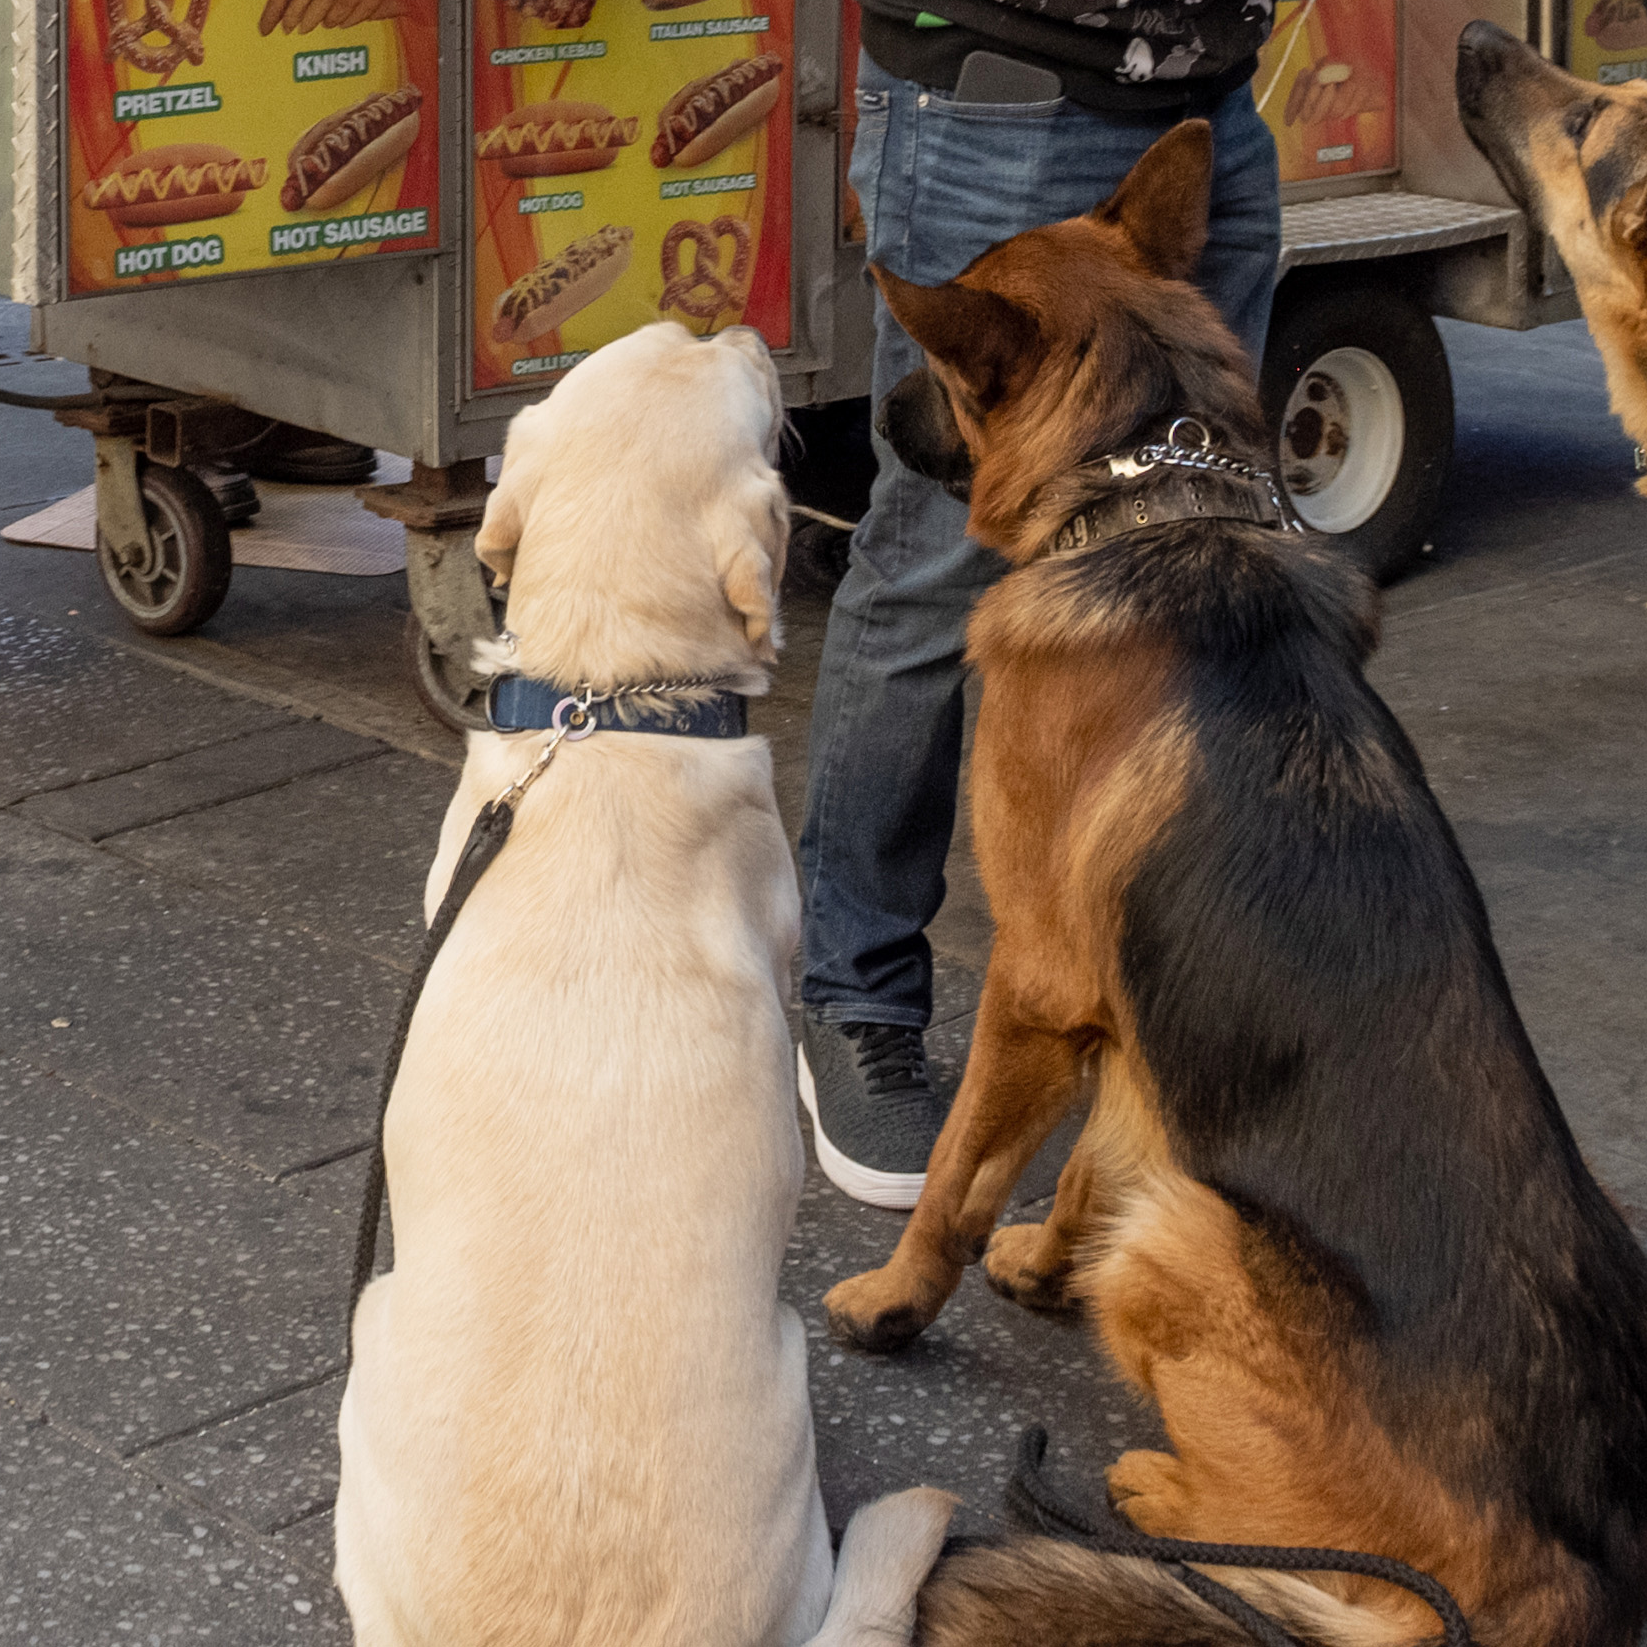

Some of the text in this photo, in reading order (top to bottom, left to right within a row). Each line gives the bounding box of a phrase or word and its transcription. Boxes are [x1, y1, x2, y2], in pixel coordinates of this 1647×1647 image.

[651, 16, 770, 41] ITALIAN SAUSAGE
[297, 50, 367, 79] KNISH
[490, 43, 606, 65] CHICKEN KEBAB
[115, 86, 220, 118] PRETZEL
[661, 174, 757, 199] HOT SAUSAGE
[519, 191, 584, 214] HOT DOG
[273, 210, 428, 252] HOT SAUSAGE
[117, 239, 222, 275] HOT DOG
[512, 357, 553, 376] CHILLI
